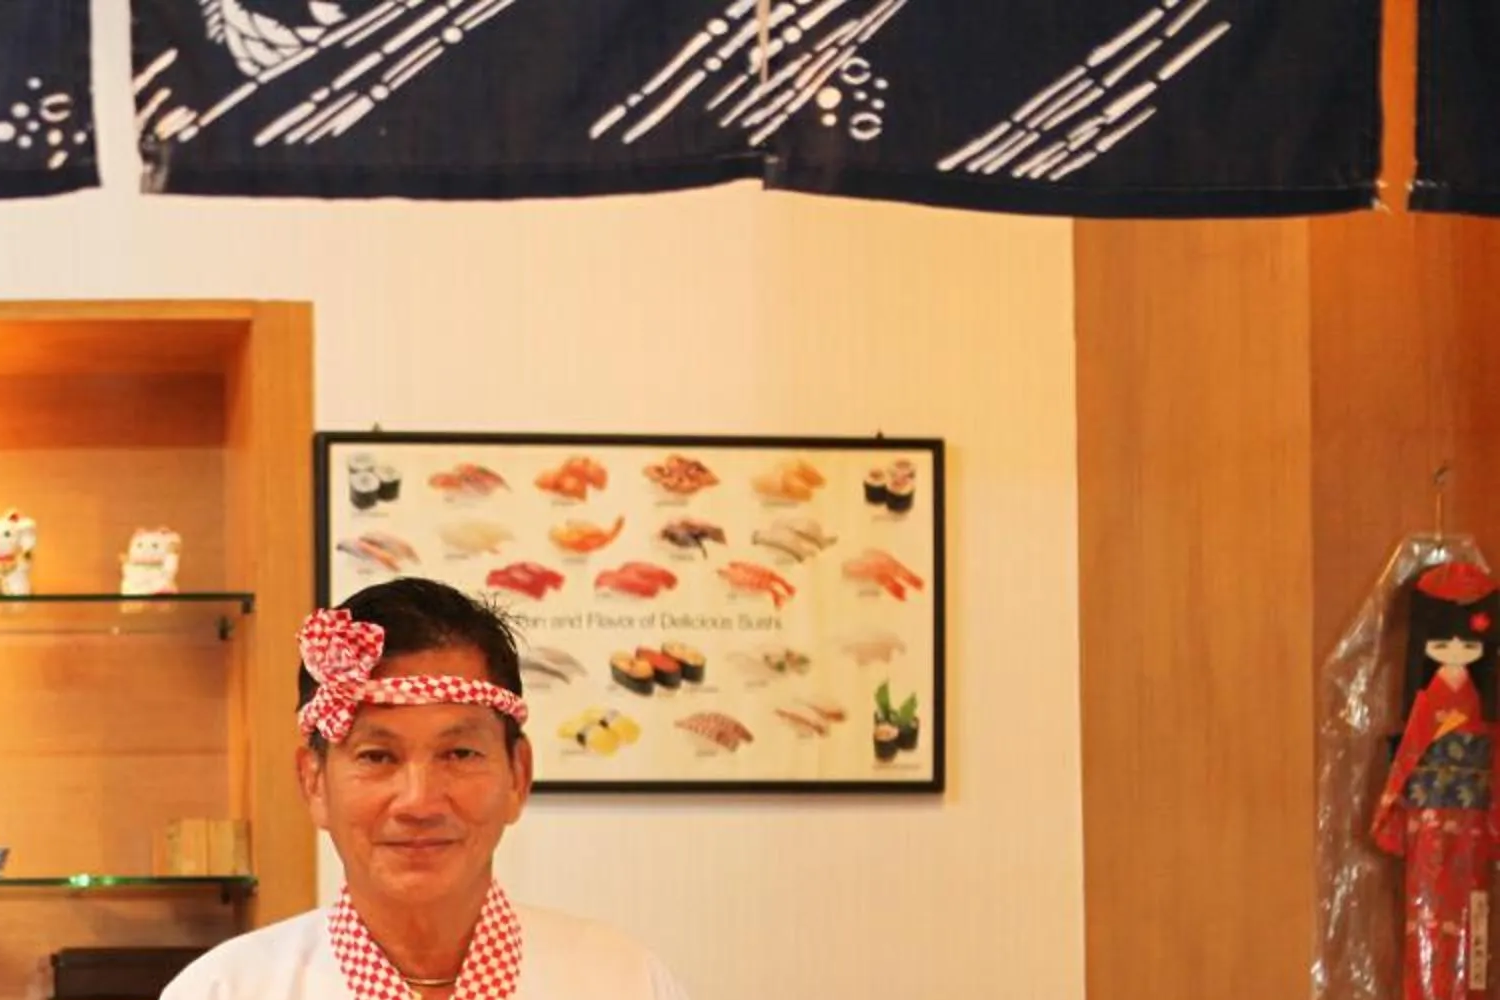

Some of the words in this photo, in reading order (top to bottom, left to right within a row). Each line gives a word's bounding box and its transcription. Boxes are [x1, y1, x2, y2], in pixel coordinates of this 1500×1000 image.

[551, 614, 581, 630] and
[586, 612, 635, 630] Flavor
[639, 612, 656, 630] of
[660, 612, 732, 630] Delicious
[737, 613, 783, 630] Sushi
